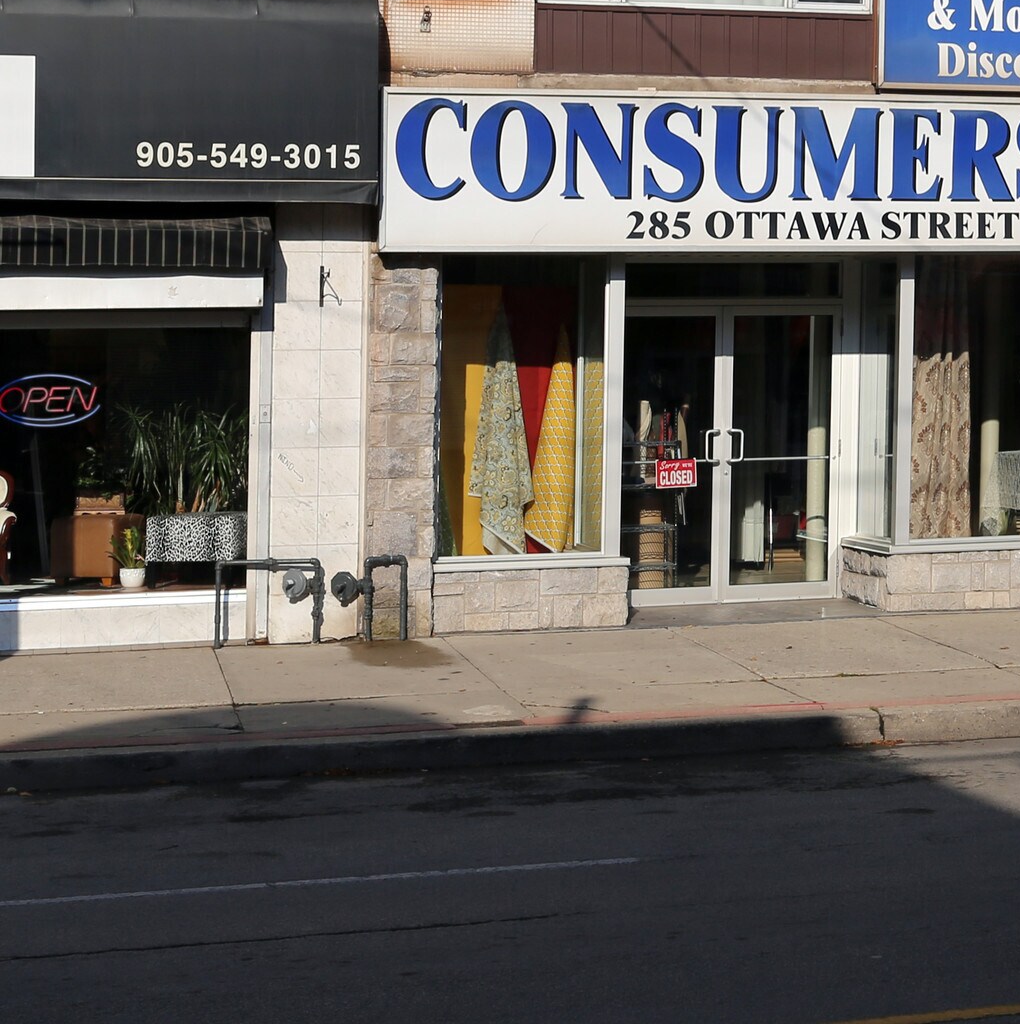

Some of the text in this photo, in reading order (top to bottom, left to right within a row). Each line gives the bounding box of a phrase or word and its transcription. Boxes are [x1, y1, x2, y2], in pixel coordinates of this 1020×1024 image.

[136, 142, 361, 169] 905-549-3015
[626, 211, 692, 239] 285
[705, 210, 871, 240] OTTAWA
[881, 211, 1020, 240] STREET
[0, 387, 97, 413] OPEN
[660, 461, 680, 470] Sorry
[660, 470, 693, 485] CLOSED
